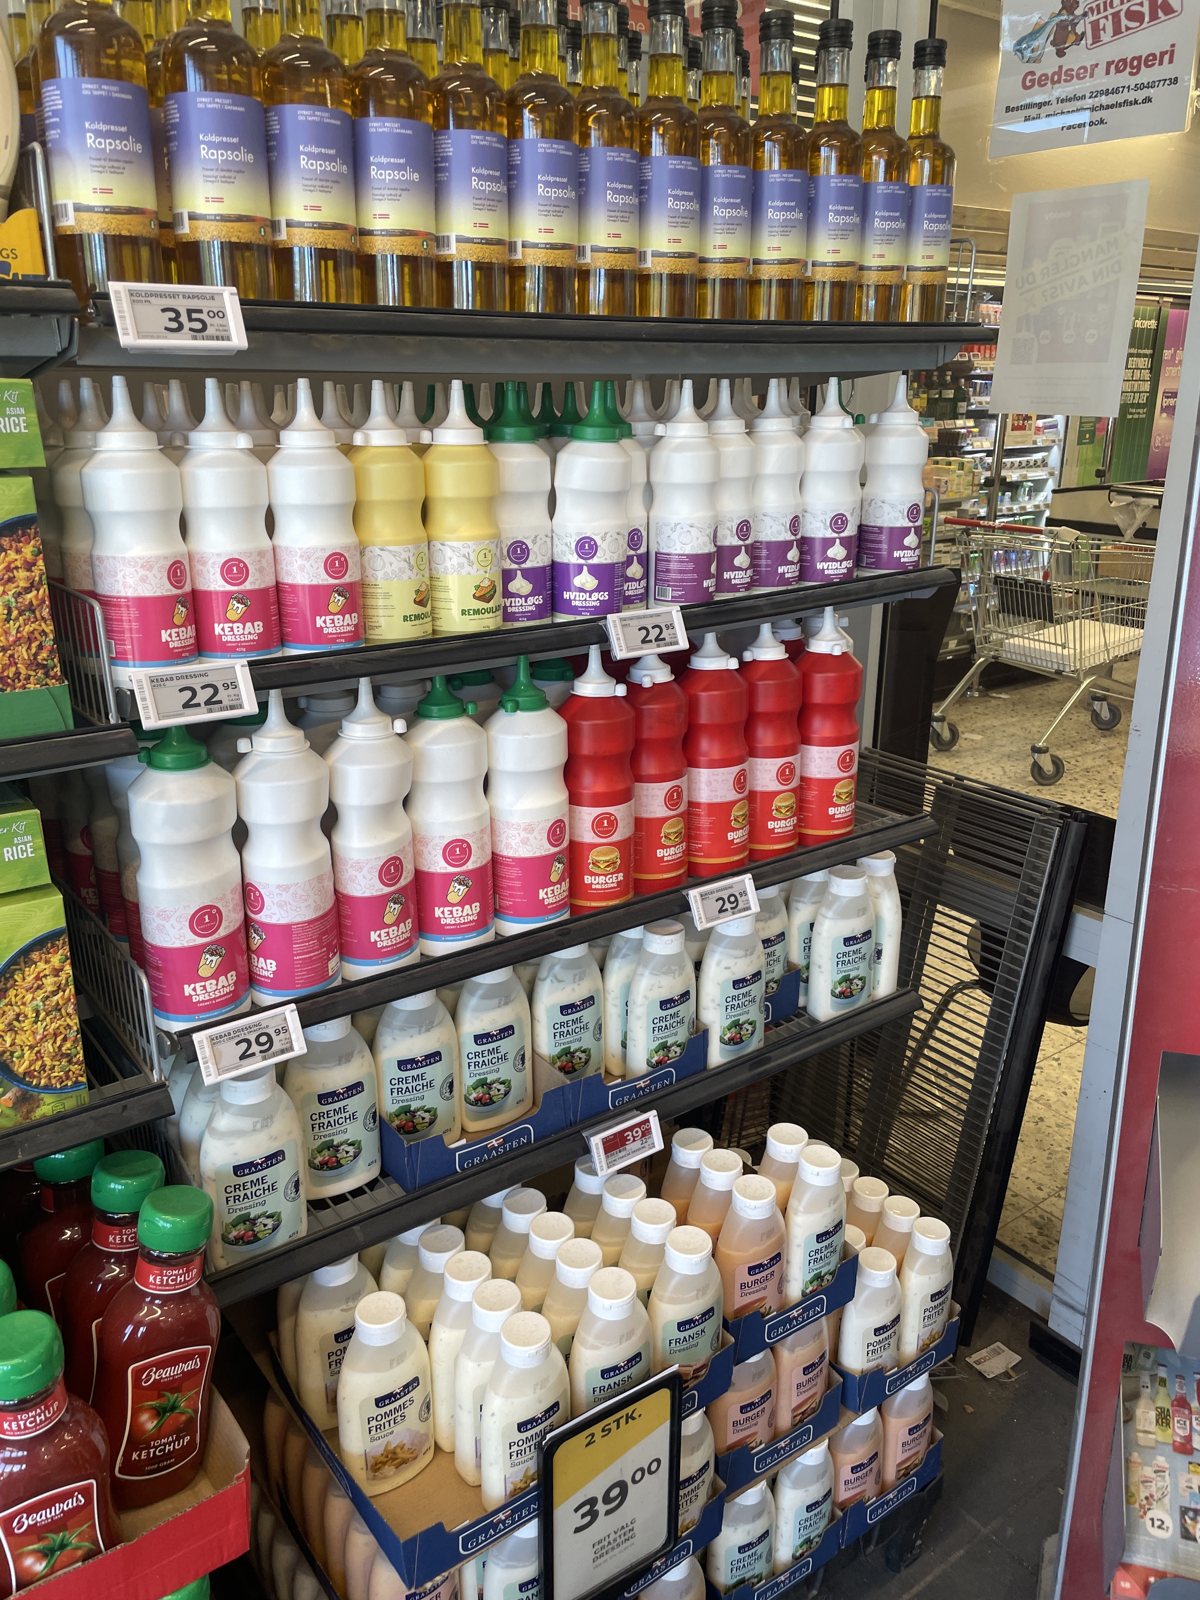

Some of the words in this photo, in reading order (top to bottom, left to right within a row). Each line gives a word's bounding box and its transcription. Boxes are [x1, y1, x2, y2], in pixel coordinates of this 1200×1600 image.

[1088, 0, 1178, 46] FISK
[1021, 63, 1099, 90] Gedser
[1105, 43, 1176, 76] røgeri
[1056, 93, 1086, 105] Telefon
[85, 121, 127, 132] Koldpresset
[87, 133, 142, 153] Rapsolie
[200, 134, 239, 144] Koldpresset
[201, 145, 254, 163] Rapsolie
[300, 145, 336, 154] Koldpresset
[300, 156, 348, 174] Rapsolie
[370, 156, 405, 164] Koldpresset
[371, 166, 419, 183] Rapsolie
[538, 184, 575, 199] Rapsolie
[768, 209, 803, 222] Rapsolie
[161, 307, 208, 333] 35
[6, 407, 25, 415] ASIAN
[816, 559, 853, 571] HVIDLØGS
[563, 591, 608, 601] HVIDLØGS
[571, 599, 600, 607] DRESSING
[214, 621, 263, 635] KEBAB
[316, 612, 359, 628] KEBAB
[222, 633, 258, 642] DRESSING
[323, 624, 355, 634] DRESSING
[638, 624, 666, 644] 22
[176, 672, 209, 681] DRESSING
[178, 683, 222, 709] 22
[222, 681, 237, 690] 95
[768, 816, 797, 830] BURGER
[13, 833, 32, 844] ASIAN
[4, 842, 34, 862] RICE
[657, 842, 686, 858] BURGER
[584, 872, 624, 885] BURGER
[435, 902, 480, 918] KEBAB
[716, 894, 739, 913] 29
[441, 913, 478, 925] DRESSING
[370, 918, 412, 942] KEBAB
[377, 931, 411, 948] DRESSING
[836, 947, 862, 960] CREME
[836, 953, 867, 968] FRAICHE
[251, 957, 277, 972] BAB
[183, 971, 237, 997] KEBAB
[192, 983, 235, 1003] DRESSING
[725, 989, 752, 1003] CREME
[725, 996, 756, 1013] FRAICHE
[552, 1015, 584, 1031] CREME
[652, 1009, 681, 1025] CREME
[211, 1032, 232, 1041] KEBAB
[233, 1022, 262, 1035] DRESSING
[553, 1022, 590, 1040] FRAICHE
[652, 1017, 686, 1035] FRAICHE
[235, 1032, 273, 1061] 29
[274, 1026, 288, 1036] 95
[554, 1036, 582, 1048] Dressing
[466, 1045, 502, 1060] CREME
[467, 1052, 509, 1070] FRAICHE
[400, 1056, 441, 1071] GRAASTEN
[389, 1072, 427, 1087] CREME
[468, 1067, 500, 1078] Dressing
[321, 1085, 363, 1105] GRAASTEN
[390, 1079, 436, 1097] FRAICHE
[615, 1078, 670, 1108] GRAASTEN
[391, 1093, 425, 1105] Dressing
[309, 1104, 349, 1122] CREME
[311, 1110, 359, 1132] FRAICHE
[313, 1127, 348, 1141] Dressing
[624, 1127, 642, 1144] 39
[464, 1134, 528, 1169] GRAASTEN
[237, 1154, 284, 1177] GRAASTEN
[224, 1174, 268, 1195] CREME
[225, 1181, 278, 1206] FRAICHE
[227, 1198, 267, 1215] Dressing
[108, 1234, 135, 1244] KETC
[808, 1241, 835, 1257] CREME
[808, 1246, 839, 1267] FRAICHE
[149, 1268, 197, 1285] KETCHUP
[162, 1267, 186, 1277] TOMAT
[740, 1271, 775, 1290] BURGER
[770, 1303, 823, 1338] GRAASTEN
[923, 1306, 944, 1323] FRITES
[668, 1326, 707, 1347] FRANSK
[867, 1329, 897, 1350] POMMES
[867, 1341, 891, 1357] FRITES
[141, 1354, 201, 1387] Beauvais
[796, 1367, 824, 1391] BURGER
[592, 1372, 633, 1395] FRANSK
[3, 1401, 59, 1431] KETCHUP
[17, 1405, 45, 1421] TOMAT
[367, 1396, 415, 1426] POMMES
[732, 1407, 766, 1428] BURGER
[368, 1412, 406, 1436] FRITES
[585, 1432, 595, 1447] 2
[601, 1408, 642, 1438] STK.
[150, 1434, 177, 1447] TOMAT
[369, 1429, 394, 1443] Sauce
[131, 1435, 191, 1461] KETCHUP
[509, 1443, 538, 1460] FRITE
[759, 1433, 809, 1468] GRAASTEN
[510, 1454, 534, 1468] Sauce
[843, 1467, 873, 1487] BURGER
[573, 1479, 629, 1534] 39
[871, 1485, 915, 1520] GRAASTEN
[12, 1491, 85, 1534] Beauvais
[467, 1500, 538, 1549] GRAASTEN
[592, 1533, 613, 1548] FRIT
[614, 1517, 636, 1536] VALG
[592, 1534, 636, 1564] DRESSING
[730, 1549, 759, 1567] CREME
[630, 1548, 689, 1595] GRAASTEN
